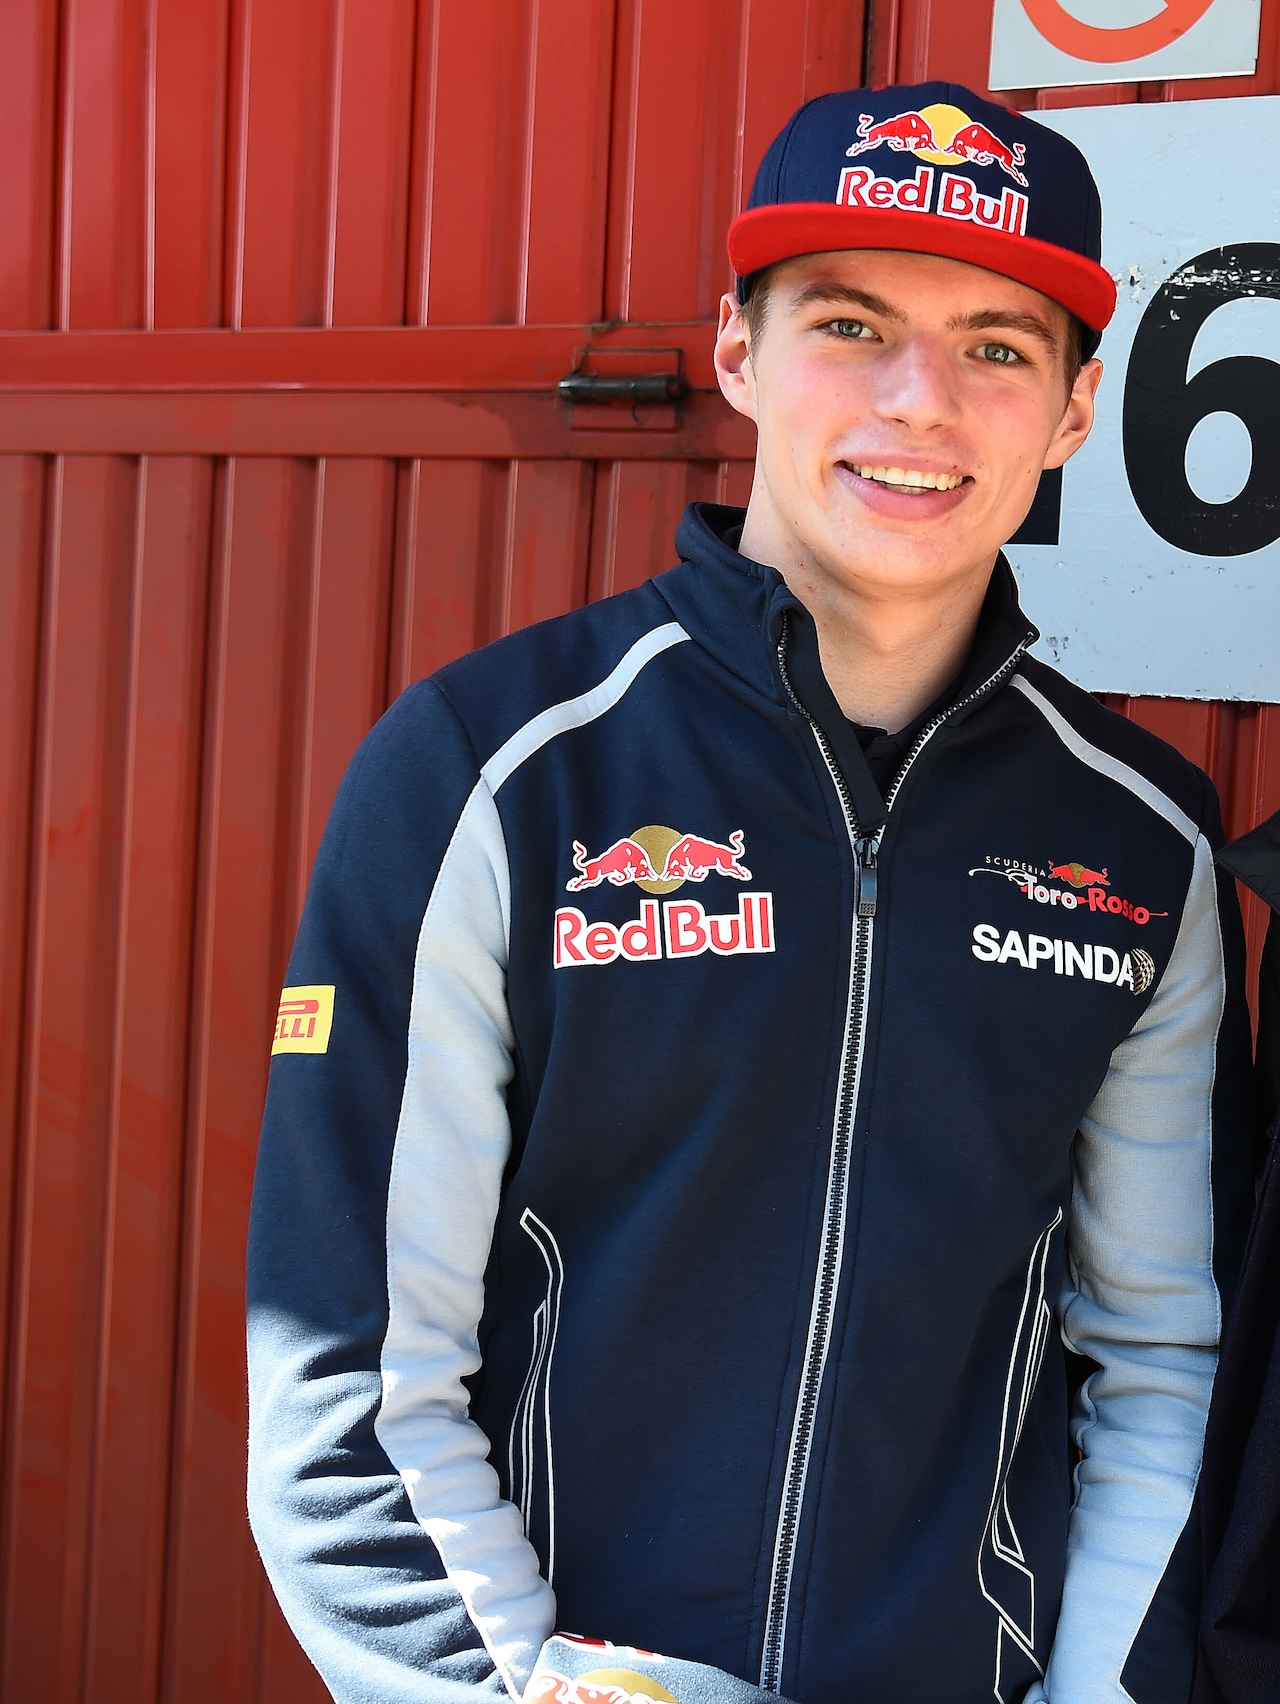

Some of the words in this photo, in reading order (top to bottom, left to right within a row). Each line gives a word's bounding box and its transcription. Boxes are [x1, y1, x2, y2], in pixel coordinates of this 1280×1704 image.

[837, 165, 934, 213] Red
[937, 171, 1029, 236] Bull
[985, 855, 1047, 877] SCUDERIA
[1024, 873, 1078, 909] Toro
[1087, 887, 1150, 925] Rosso
[554, 899, 662, 969] Red
[663, 892, 776, 959] Bull
[971, 923, 1135, 991] SAPINDA
